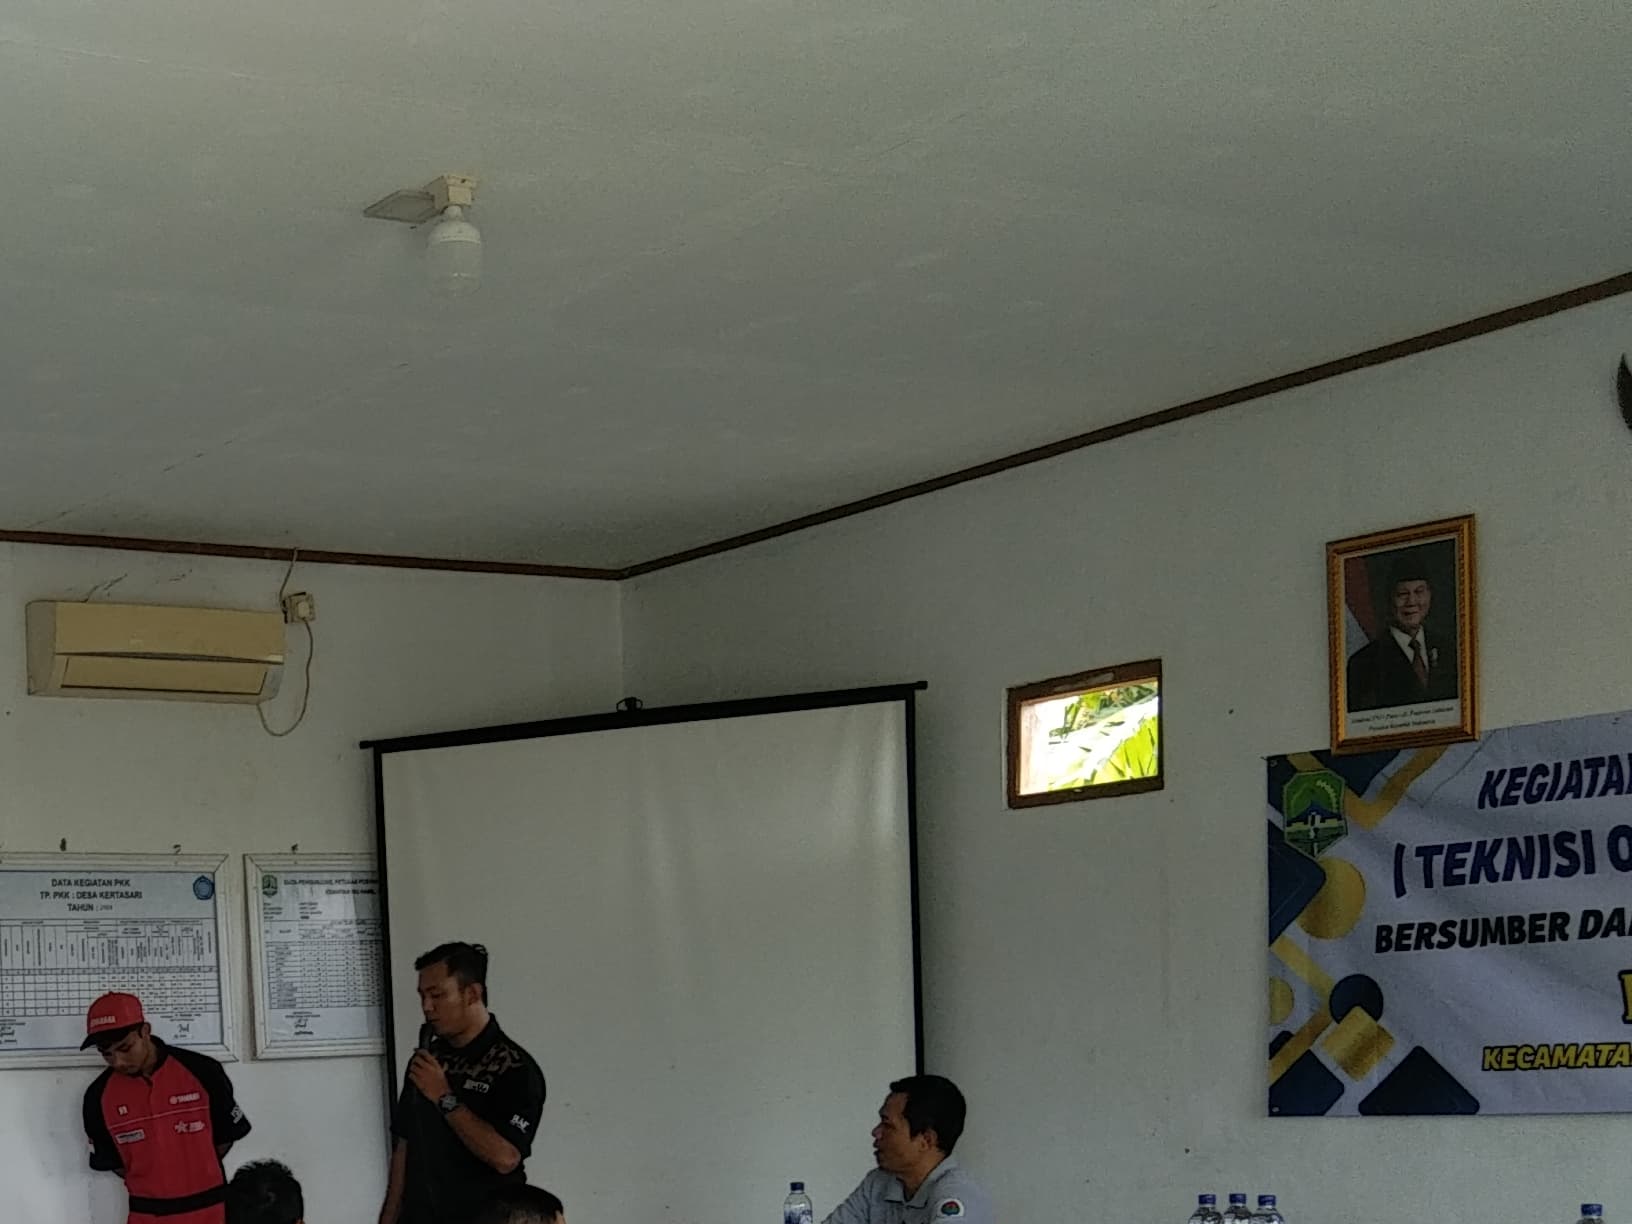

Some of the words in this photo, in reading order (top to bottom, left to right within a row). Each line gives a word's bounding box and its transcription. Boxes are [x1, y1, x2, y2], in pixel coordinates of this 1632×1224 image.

[1478, 753, 1632, 809] KEGIATA
[1415, 829, 1596, 888] TEKNISI
[51, 879, 72, 887] DATA
[73, 879, 113, 888] KEGIATAN
[114, 880, 131, 888] PKK
[53, 892, 70, 900] PKK
[76, 892, 97, 900] DESA
[99, 891, 143, 900] KERTASARI
[68, 904, 94, 912] TAHUN
[1375, 912, 1570, 953] BERSUMBER
[1578, 908, 1632, 940] DA
[1482, 1042, 1632, 1071] KECAMATA
